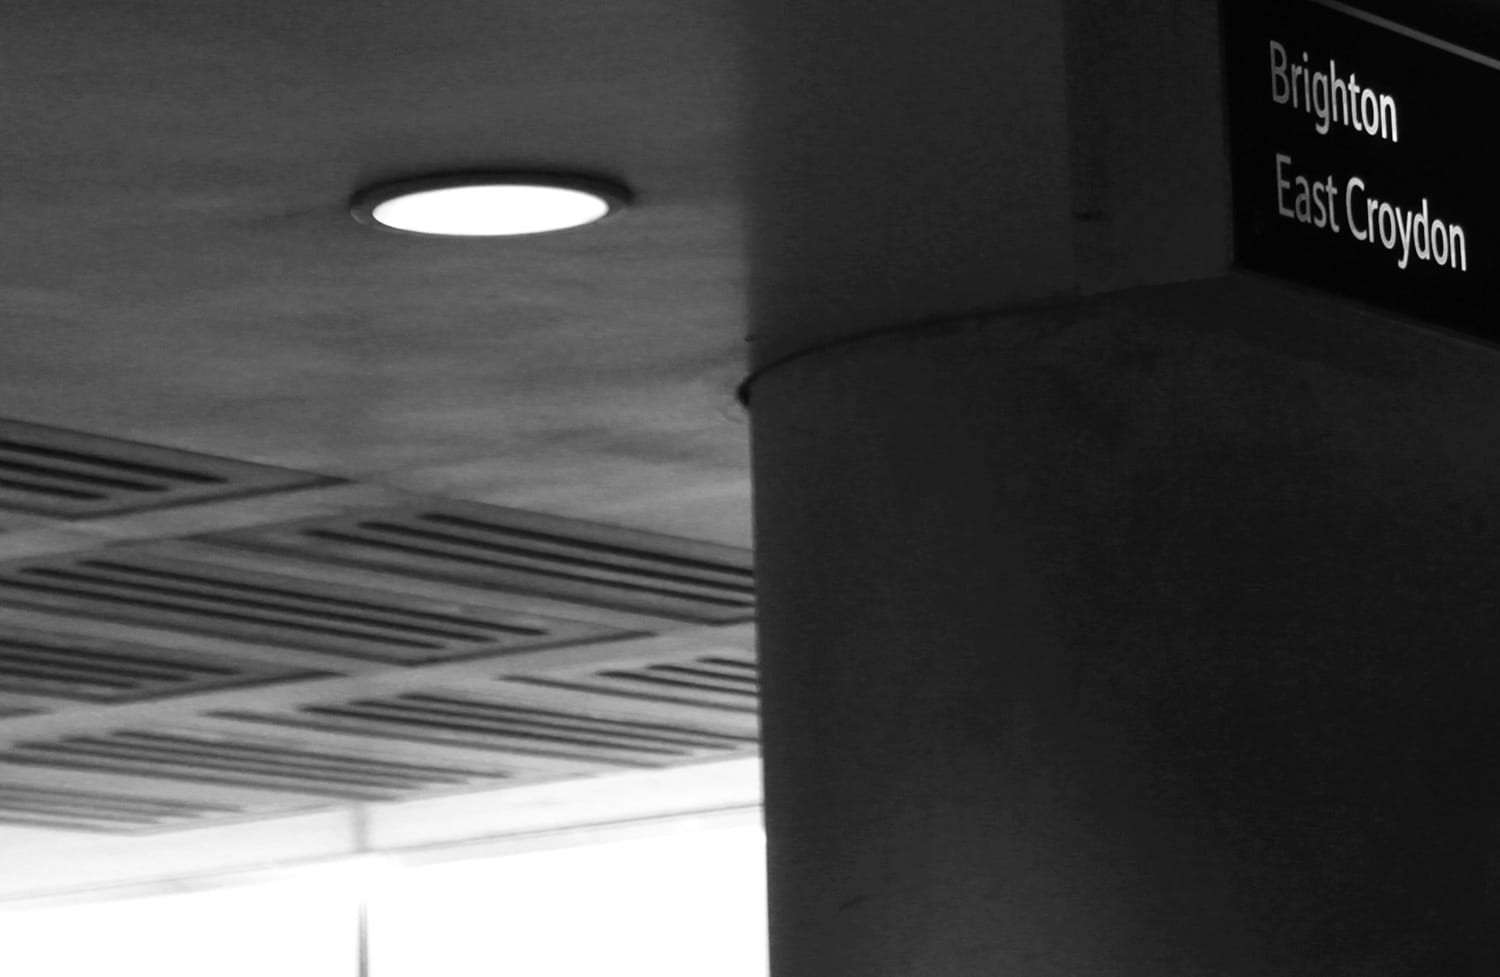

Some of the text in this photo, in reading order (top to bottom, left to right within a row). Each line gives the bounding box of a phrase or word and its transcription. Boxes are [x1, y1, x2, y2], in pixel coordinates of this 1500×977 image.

[1268, 39, 1399, 143] Brighton
[1274, 152, 1467, 272] East Croydon
